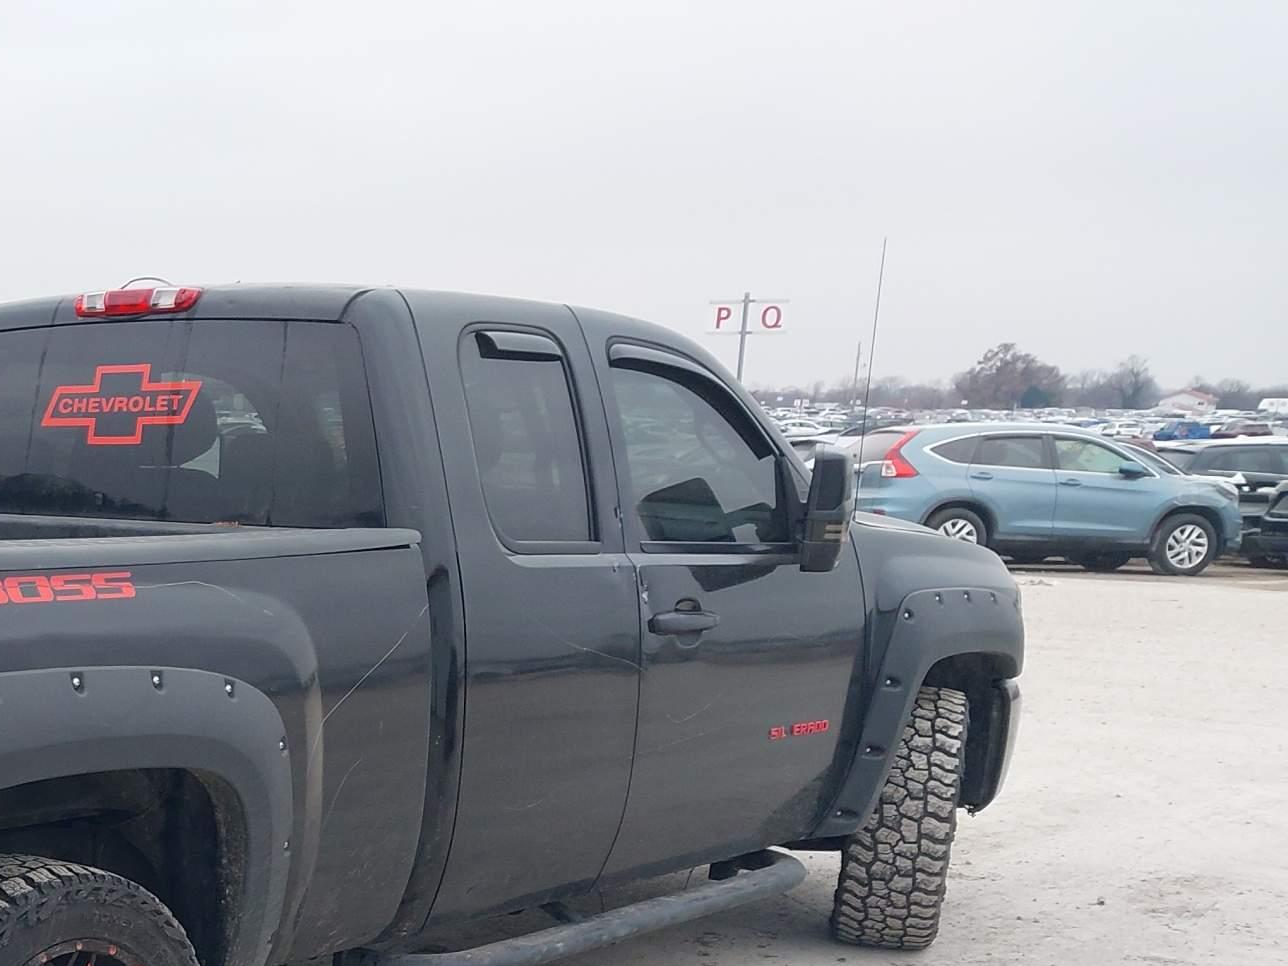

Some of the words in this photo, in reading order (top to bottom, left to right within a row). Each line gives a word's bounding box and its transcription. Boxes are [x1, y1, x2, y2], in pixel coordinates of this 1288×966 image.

[715, 307, 732, 329] P
[761, 306, 782, 328] Q
[58, 394, 184, 414] CHEVROLET
